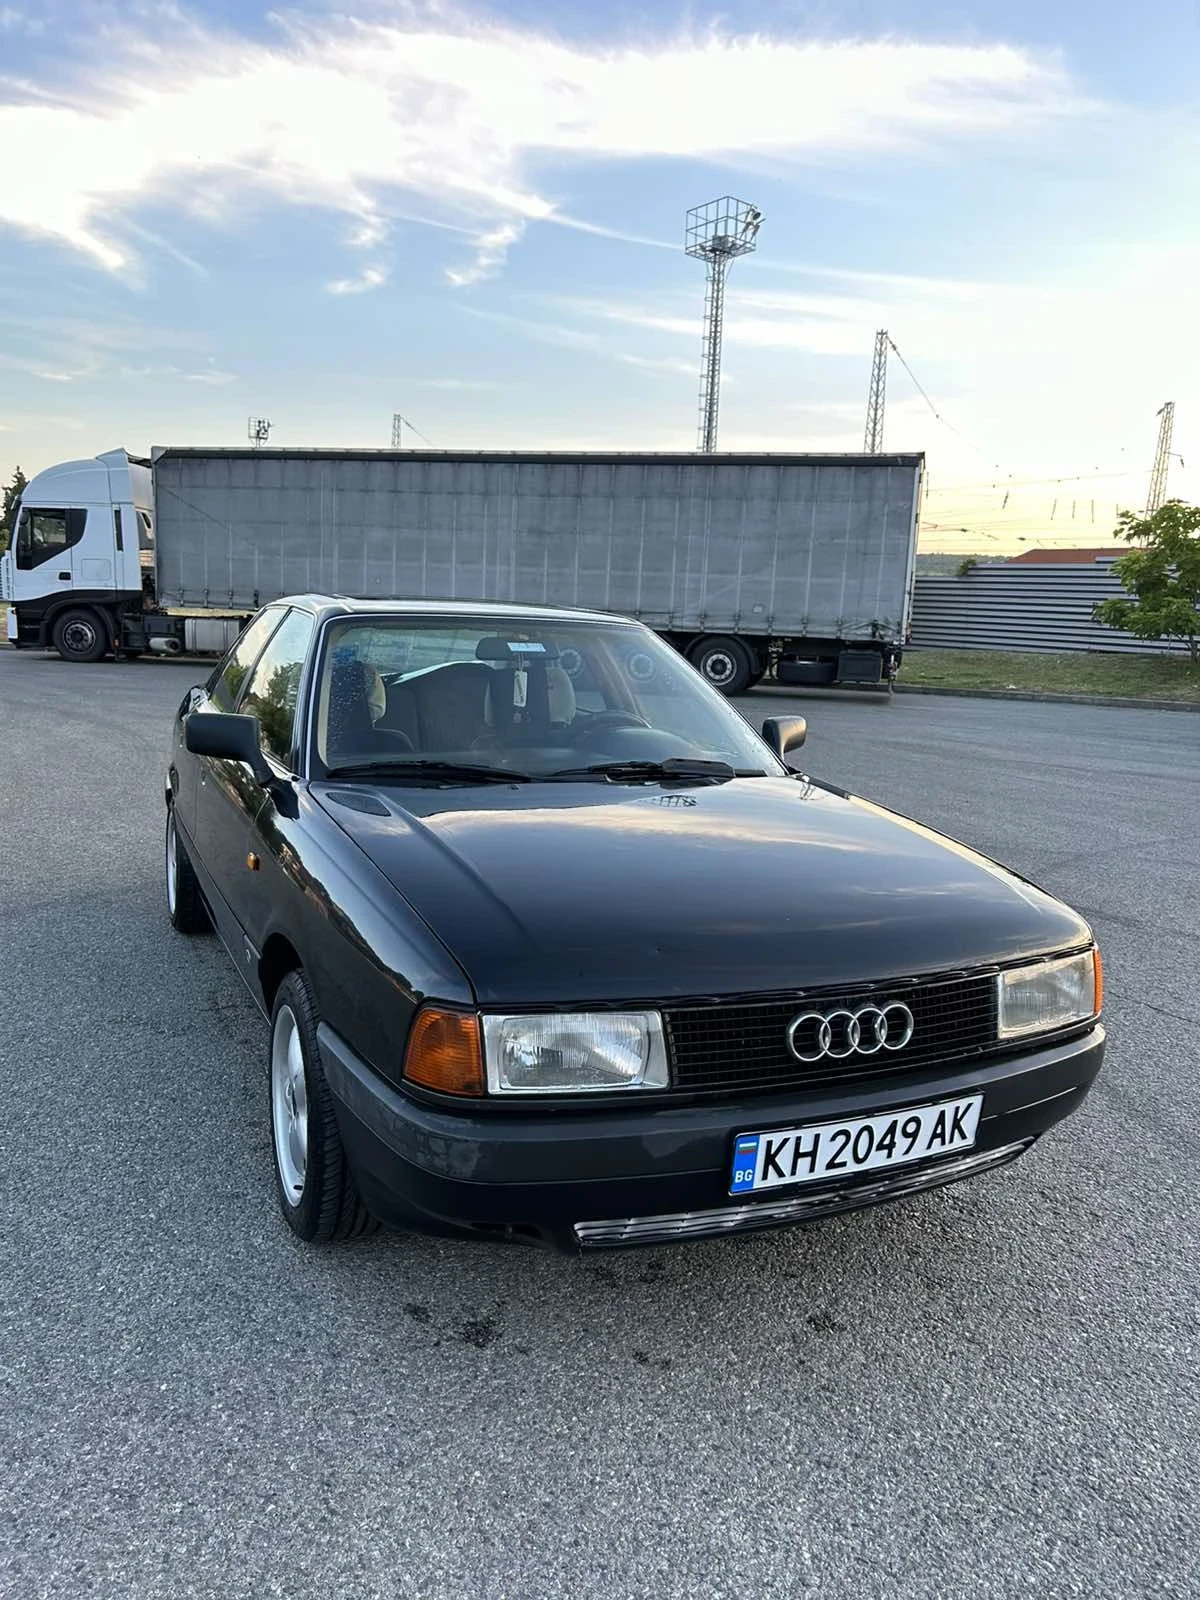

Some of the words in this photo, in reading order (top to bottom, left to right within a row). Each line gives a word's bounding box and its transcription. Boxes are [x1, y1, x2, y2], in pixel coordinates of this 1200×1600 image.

[761, 1133, 821, 1181] KH
[825, 1116, 922, 1170] 2049
[926, 1102, 974, 1150] AK
[735, 1169, 753, 1183] BG
